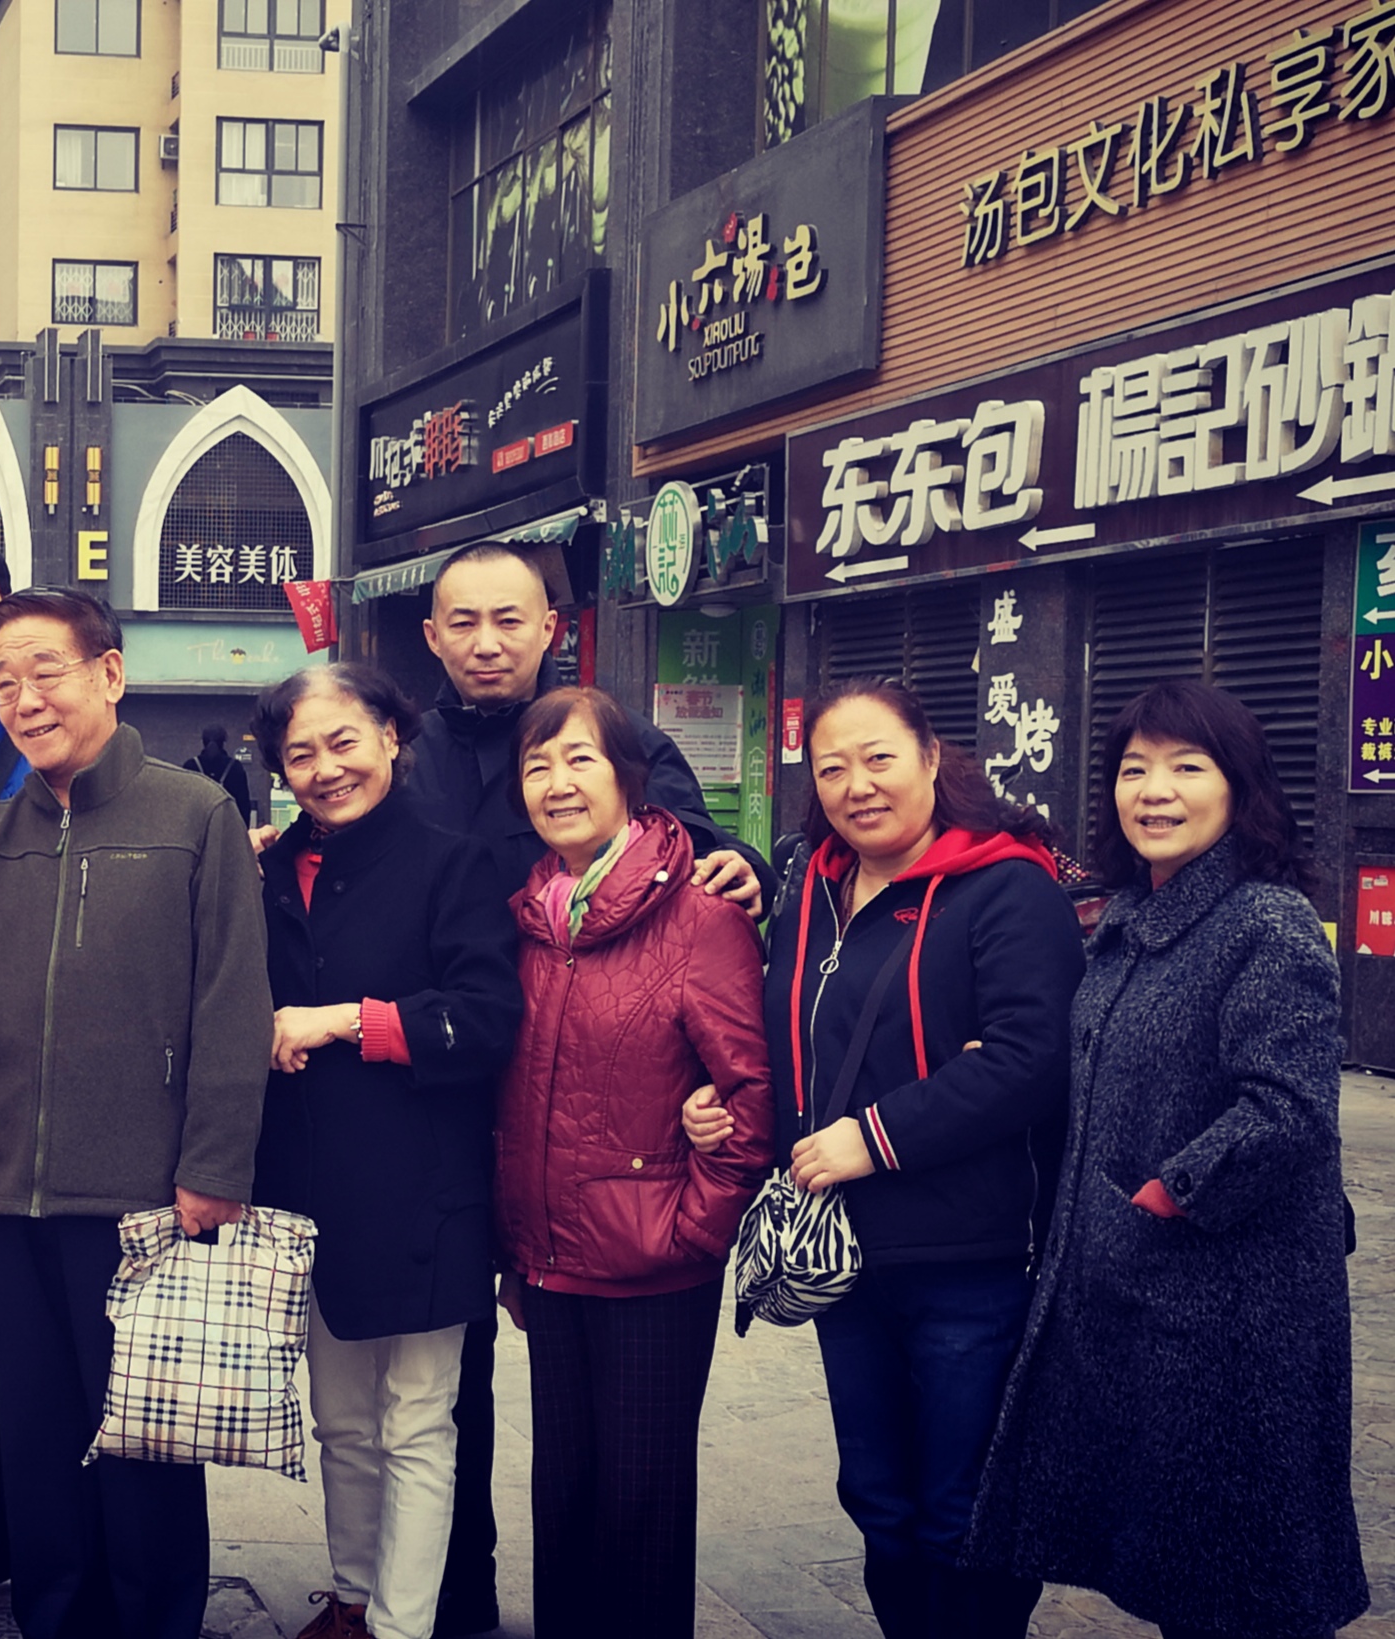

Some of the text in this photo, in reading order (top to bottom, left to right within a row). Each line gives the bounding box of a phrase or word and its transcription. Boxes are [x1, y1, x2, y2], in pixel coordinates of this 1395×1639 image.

[815, 400, 1045, 558] 东东包
[78, 531, 108, 580] E
[173, 543, 298, 585] 美容美体
[1361, 717, 1395, 737] 专业
